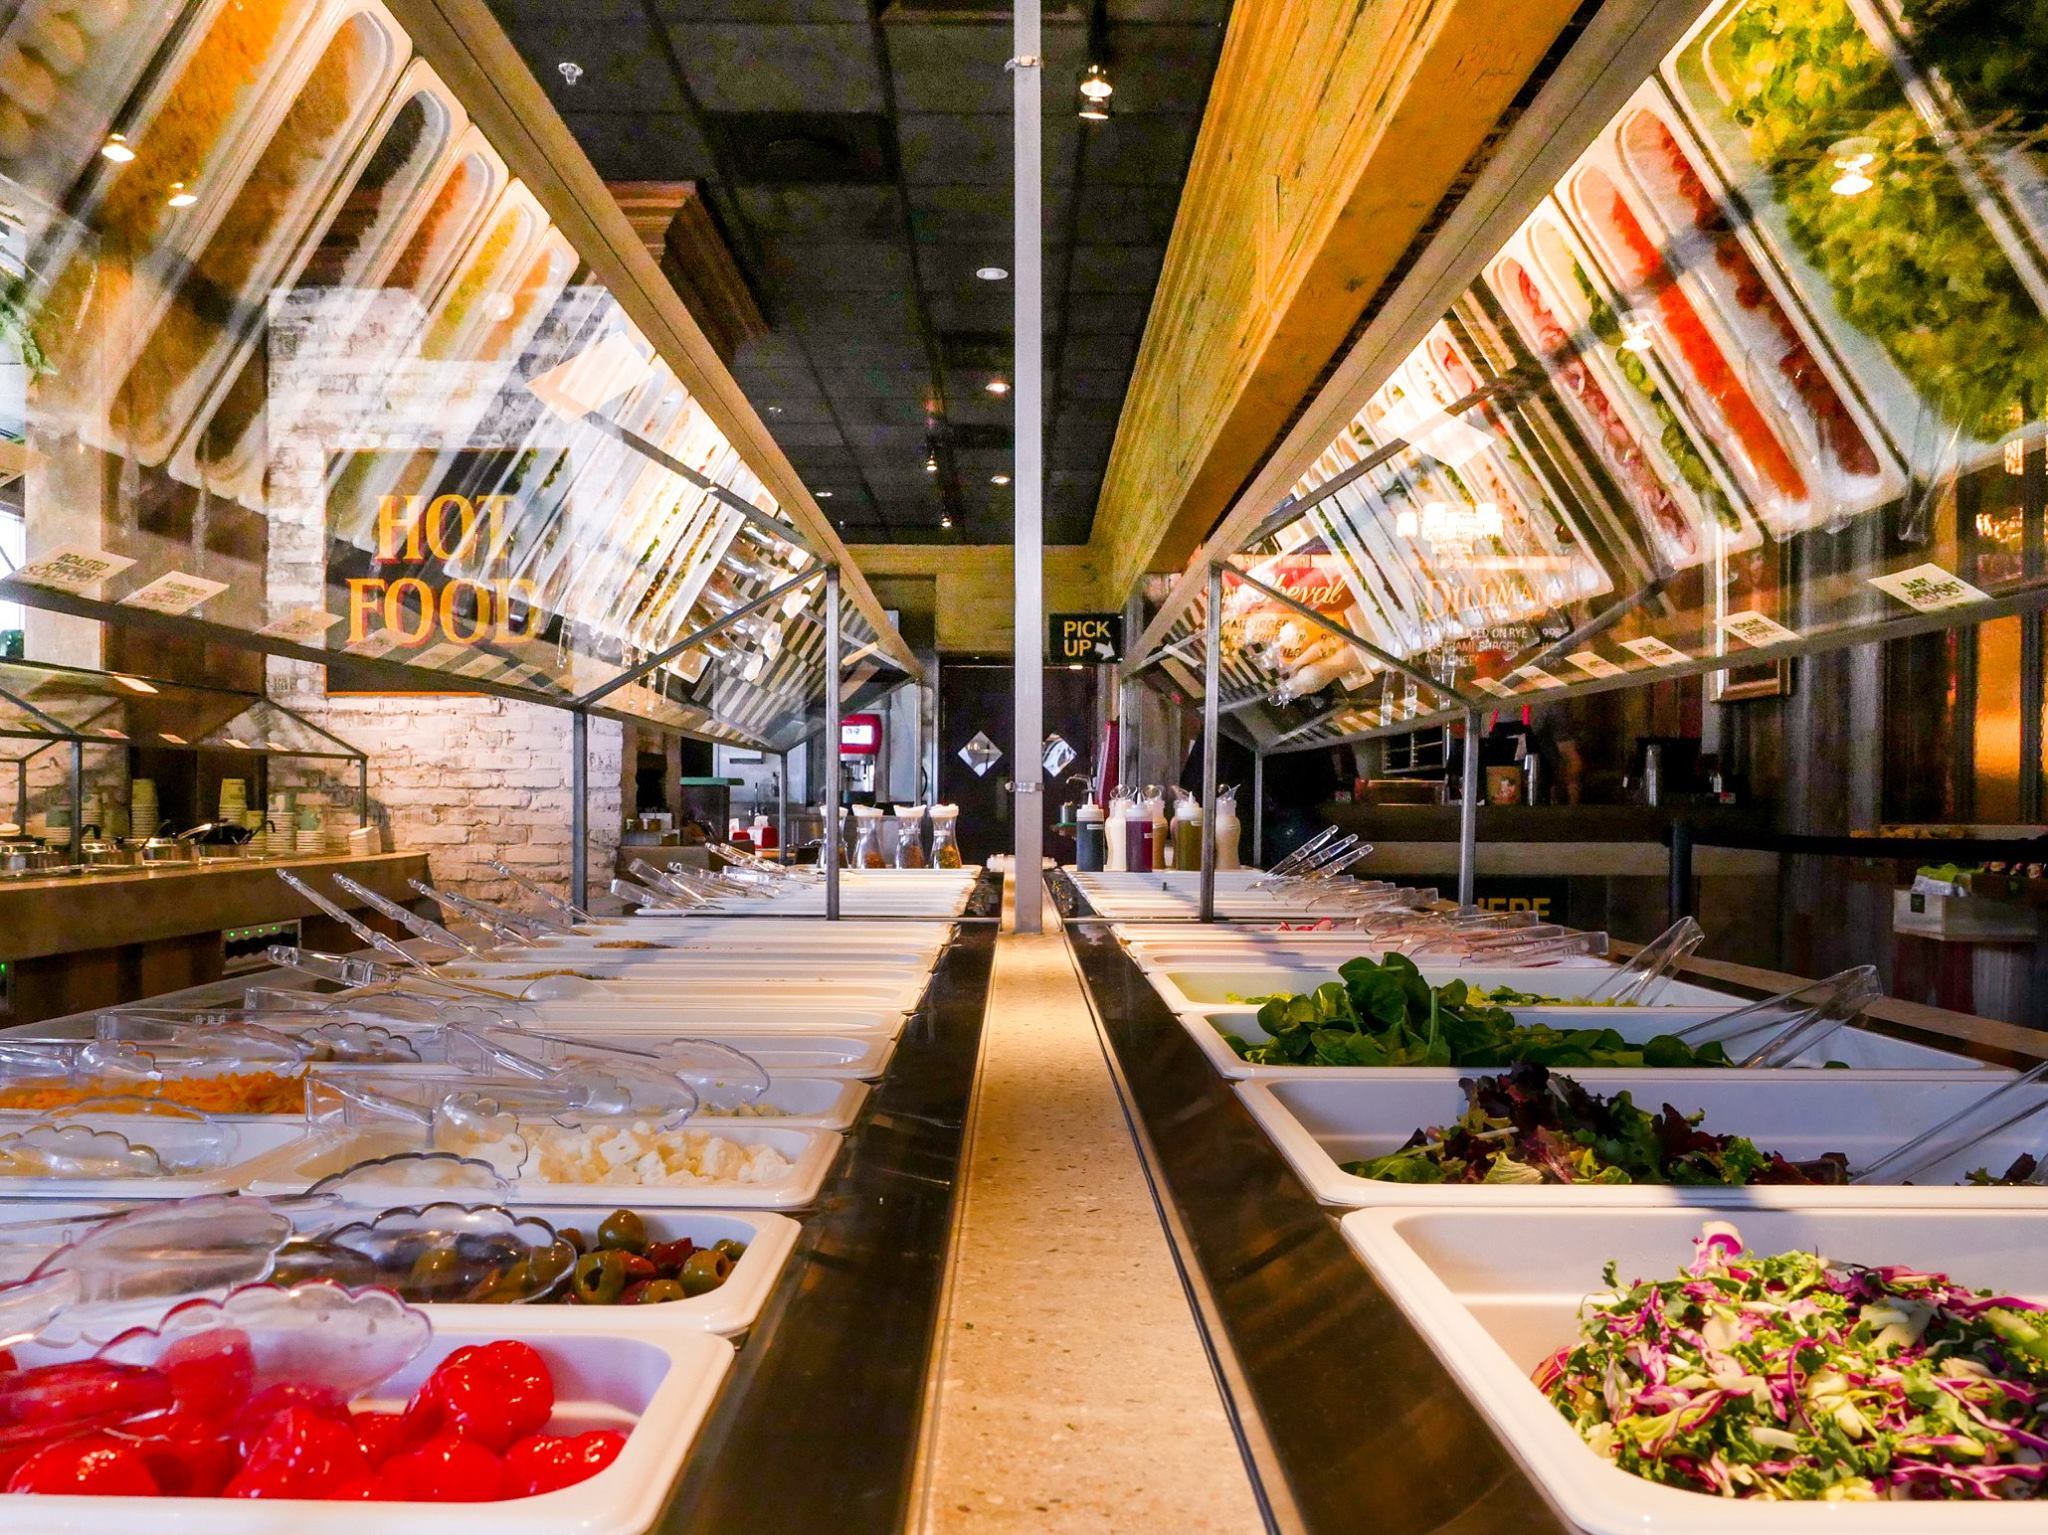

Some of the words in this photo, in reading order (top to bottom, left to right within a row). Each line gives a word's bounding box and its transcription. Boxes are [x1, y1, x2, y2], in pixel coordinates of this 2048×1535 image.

[374, 493, 518, 565] HOT
[346, 577, 541, 648] FOOD
[1064, 621, 1111, 638] PICK
[1491, 626, 1508, 638] ON
[1509, 627, 1528, 638] RYE
[1064, 640, 1092, 657] UP
[1477, 897, 1552, 917] ERE
